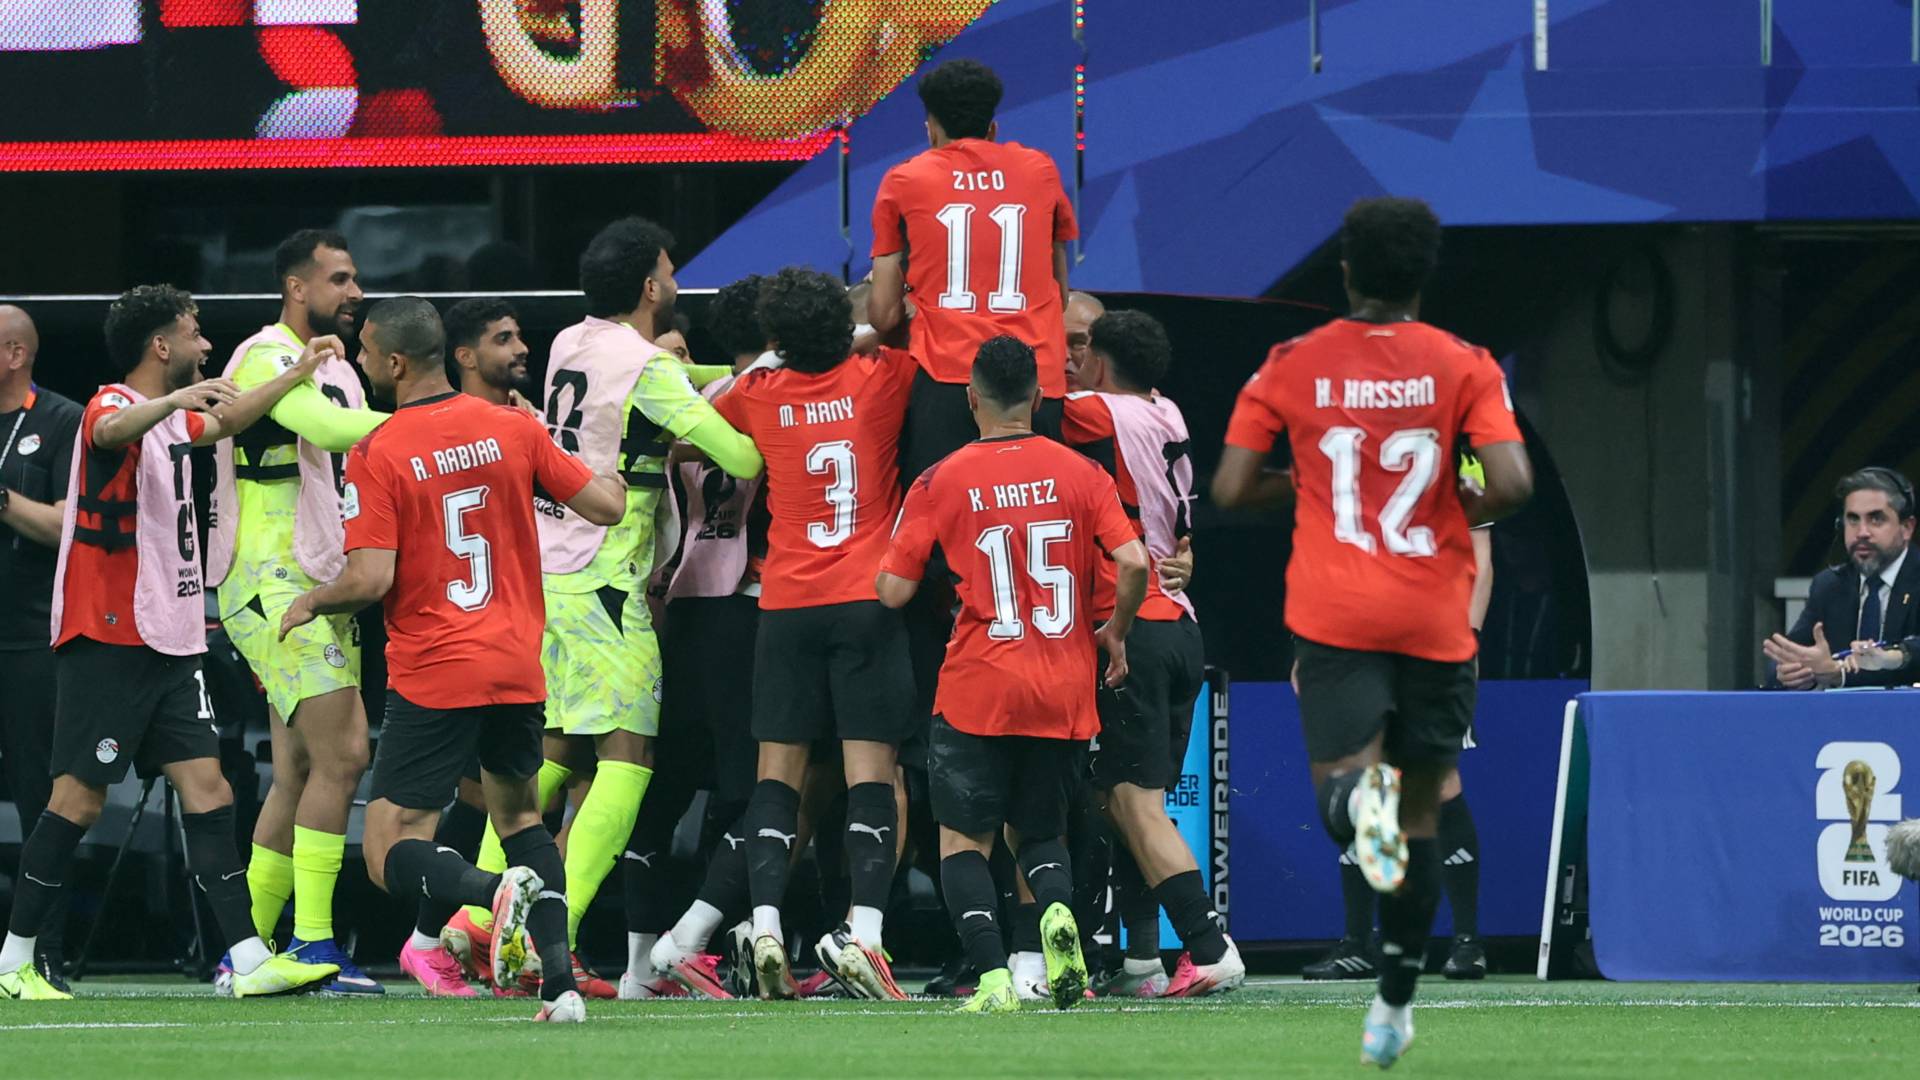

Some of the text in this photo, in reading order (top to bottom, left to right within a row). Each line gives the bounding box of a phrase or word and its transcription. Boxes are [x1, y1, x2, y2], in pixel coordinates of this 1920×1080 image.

[952, 170, 1005, 191] ZICO
[935, 203, 1027, 313] 11
[1344, 375, 1435, 409] HASSAN
[779, 396, 854, 428] M. HANY
[409, 438, 502, 482] R. RABIAA
[806, 439, 858, 549] 3
[968, 478, 1058, 512] K. HAFEZ
[1318, 426, 1441, 557] 12
[442, 485, 493, 612] 5
[975, 519, 1075, 640] 15
[1843, 870, 1880, 886] FIFA
[1819, 907, 1904, 922] WORLD CUP
[1819, 924, 1904, 948] 2026
